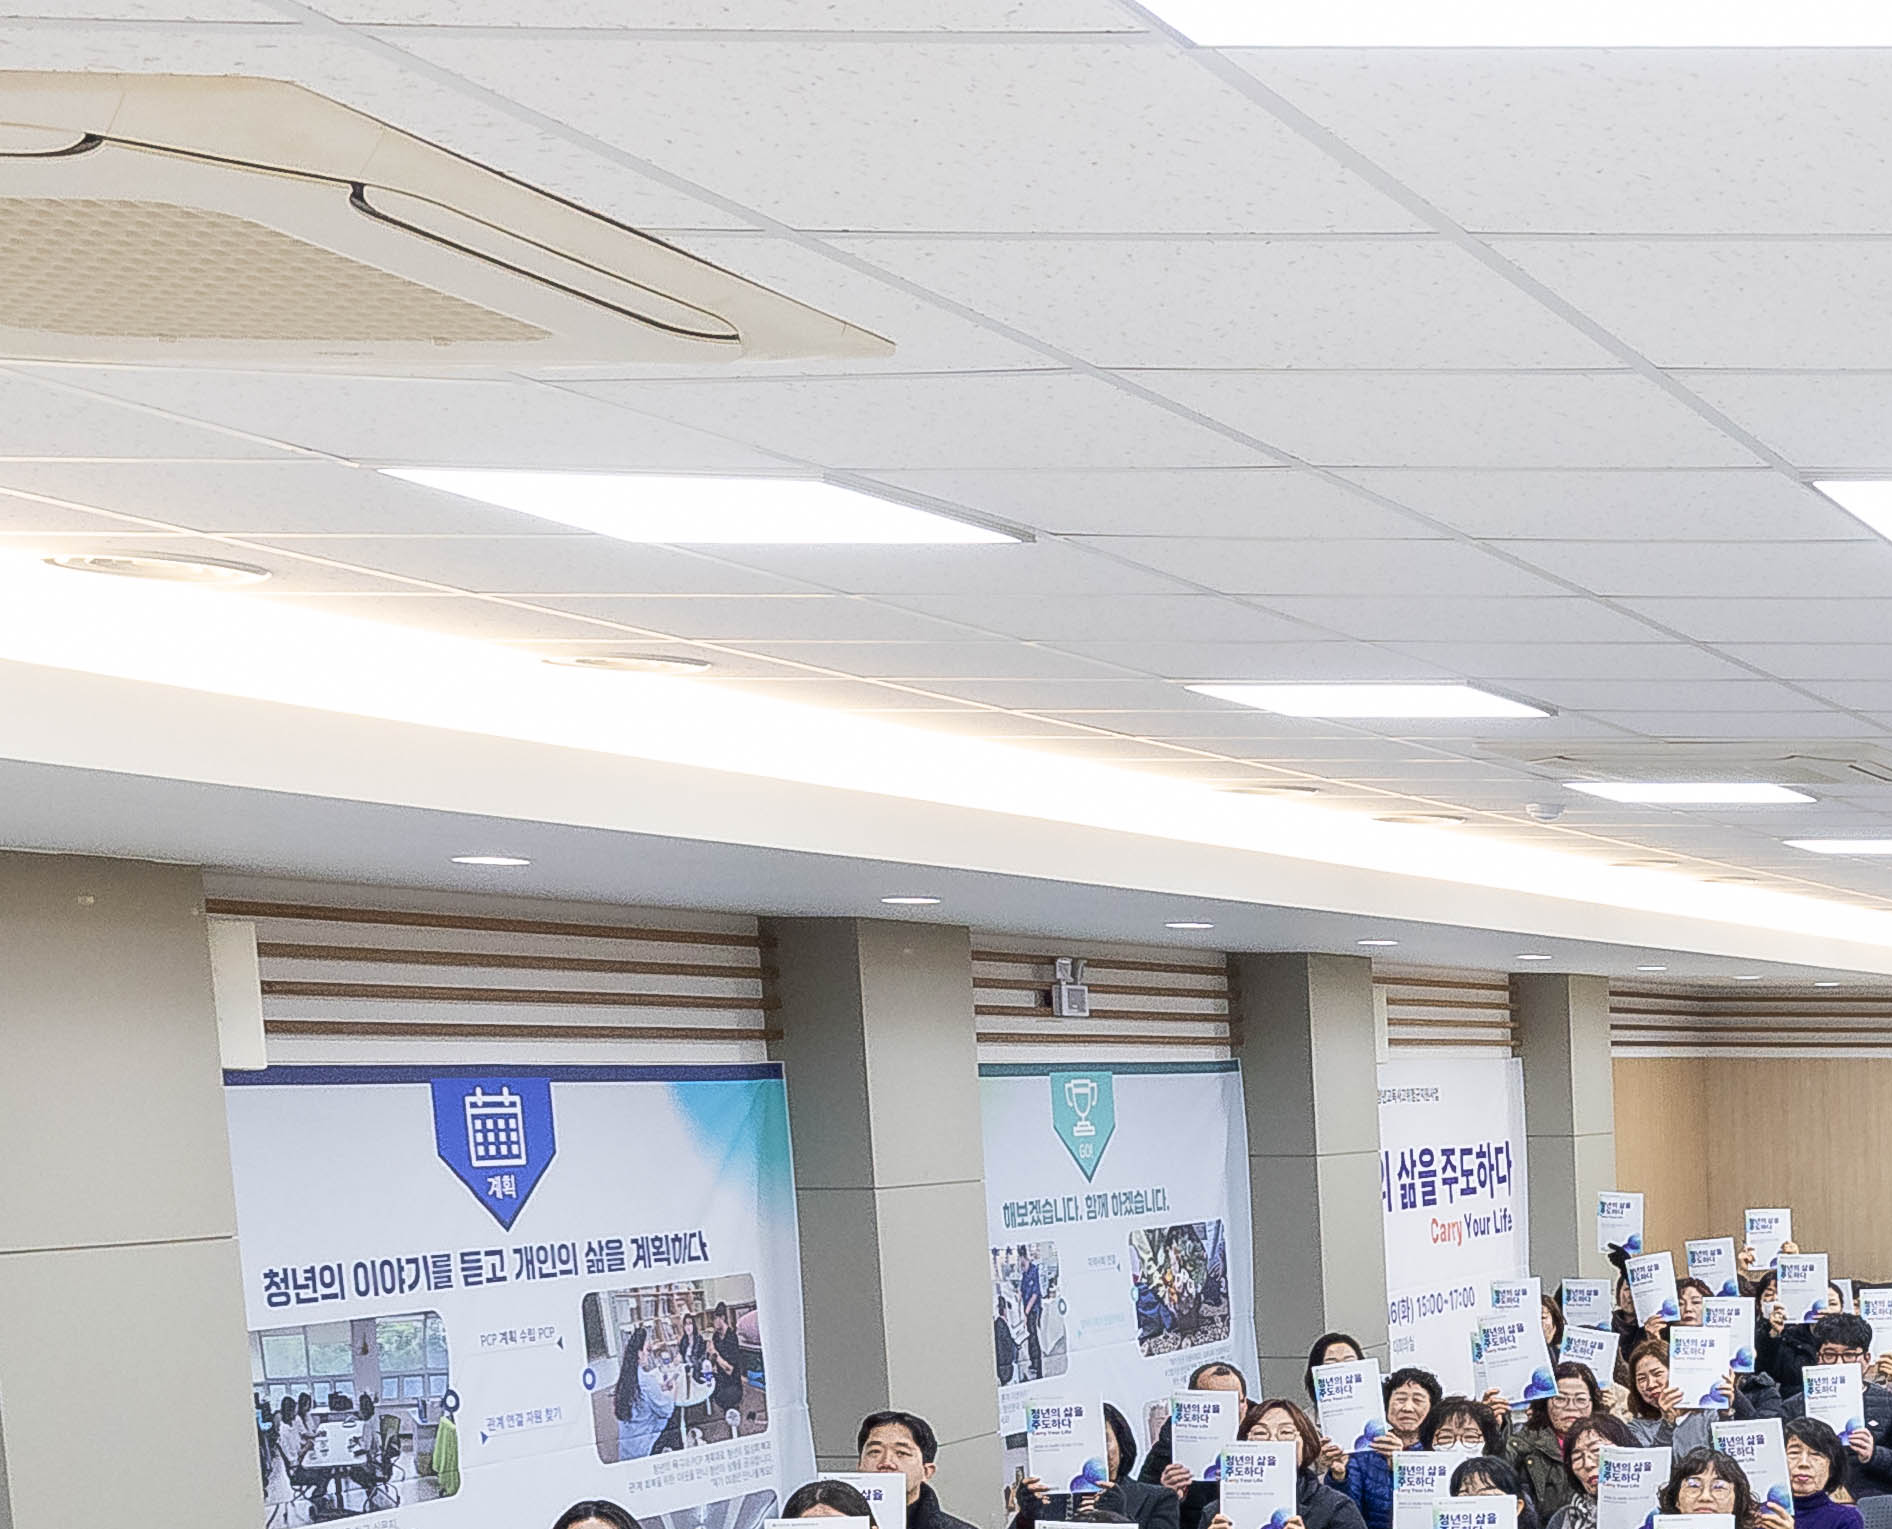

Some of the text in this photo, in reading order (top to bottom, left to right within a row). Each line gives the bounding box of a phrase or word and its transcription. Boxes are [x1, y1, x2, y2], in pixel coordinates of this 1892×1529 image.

[487, 1174, 517, 1200] 계획
[1397, 1148, 1437, 1210] 삶을
[1440, 1140, 1512, 1204] 주도하다
[1002, 1187, 1170, 1228] 해보겠습니다. 함께 하겠습니다.
[1431, 1208, 1513, 1247] Carry Your Life
[263, 1230, 710, 1308] 청년의 이야기를 듣고 개인의 삶을 계획하다
[480, 1333, 497, 1347] PCP
[538, 1327, 556, 1340] PCP
